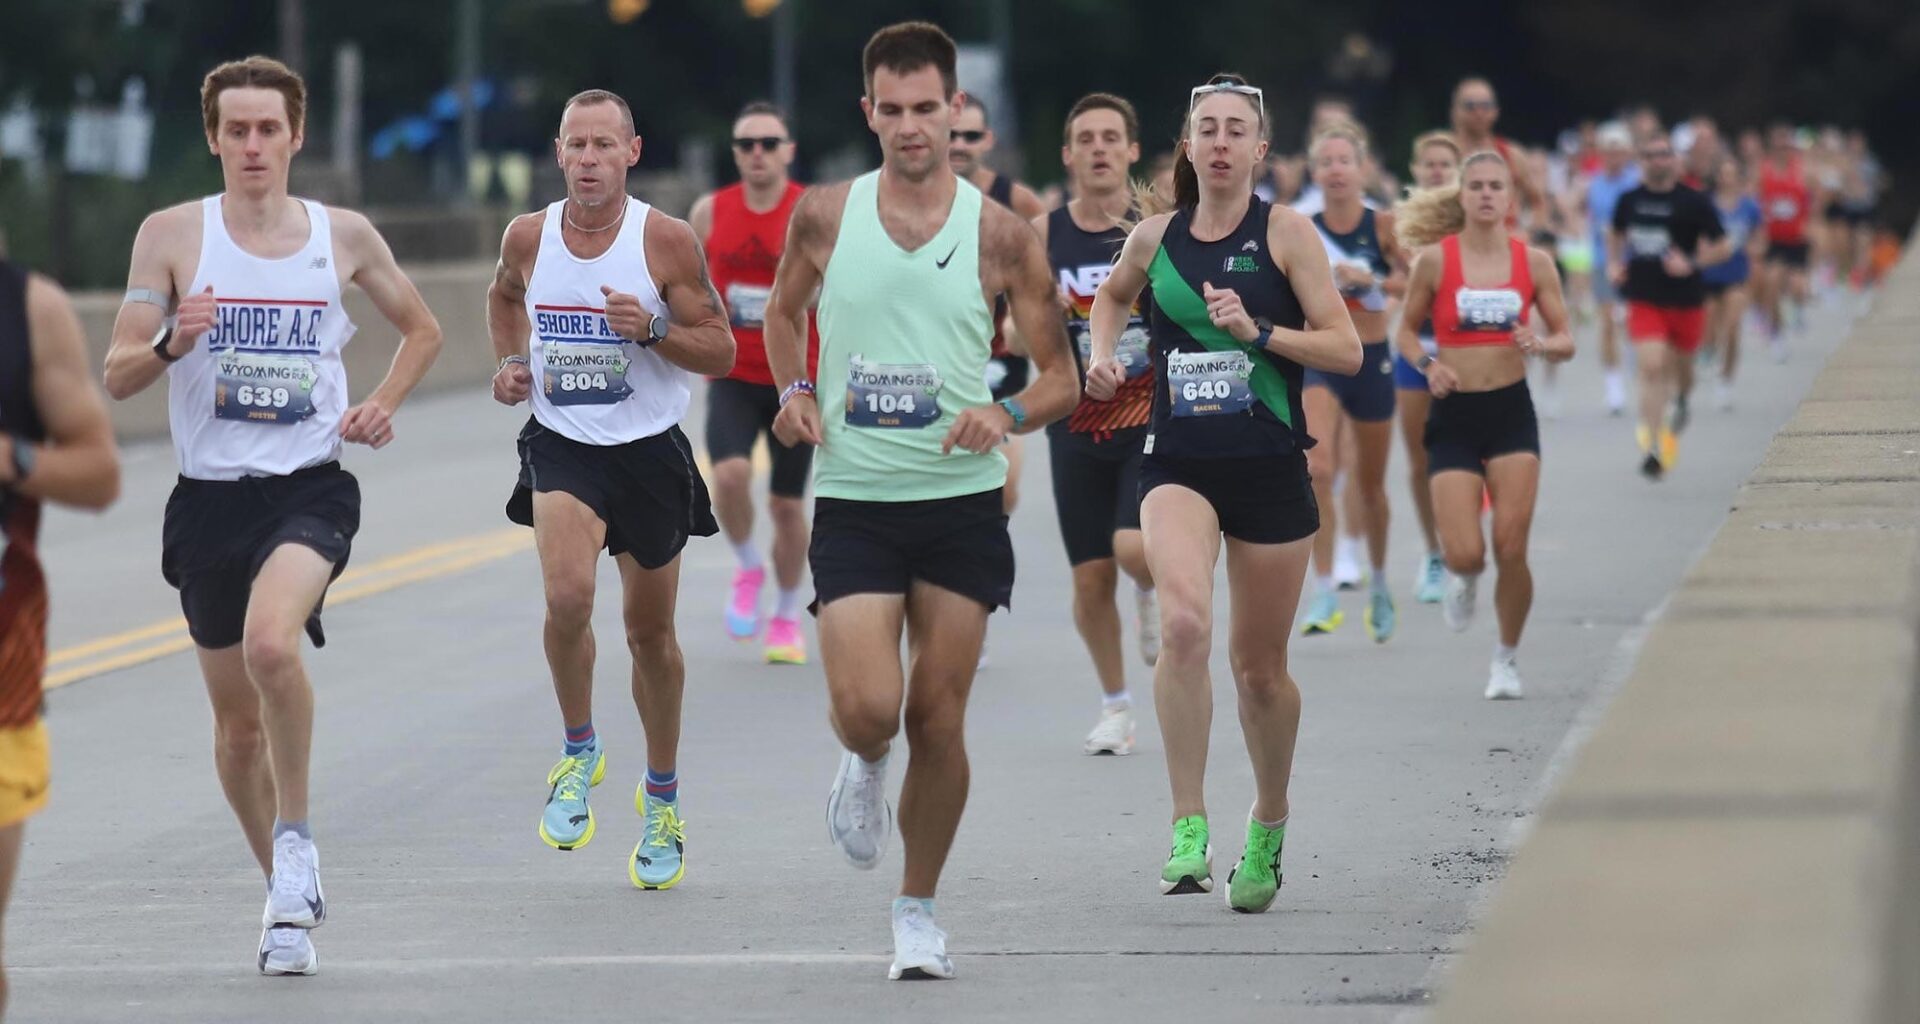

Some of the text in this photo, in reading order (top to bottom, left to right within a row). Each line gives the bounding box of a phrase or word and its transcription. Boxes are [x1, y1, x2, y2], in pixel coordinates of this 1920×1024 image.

[208, 306, 322, 348] SHORE A.C.
[536, 312, 594, 335] SHORE
[545, 354, 605, 367] WYOMING
[605, 358, 621, 367] RUN
[1169, 360, 1246, 376] WYOMING RUN
[221, 362, 310, 380] WYOMING RUN
[850, 369, 915, 387] WYOMING
[560, 372, 608, 392] 804
[1182, 380, 1231, 401] 640
[237, 385, 289, 408] 639
[865, 393, 916, 414] 104
[247, 411, 278, 420] JUSTIN
